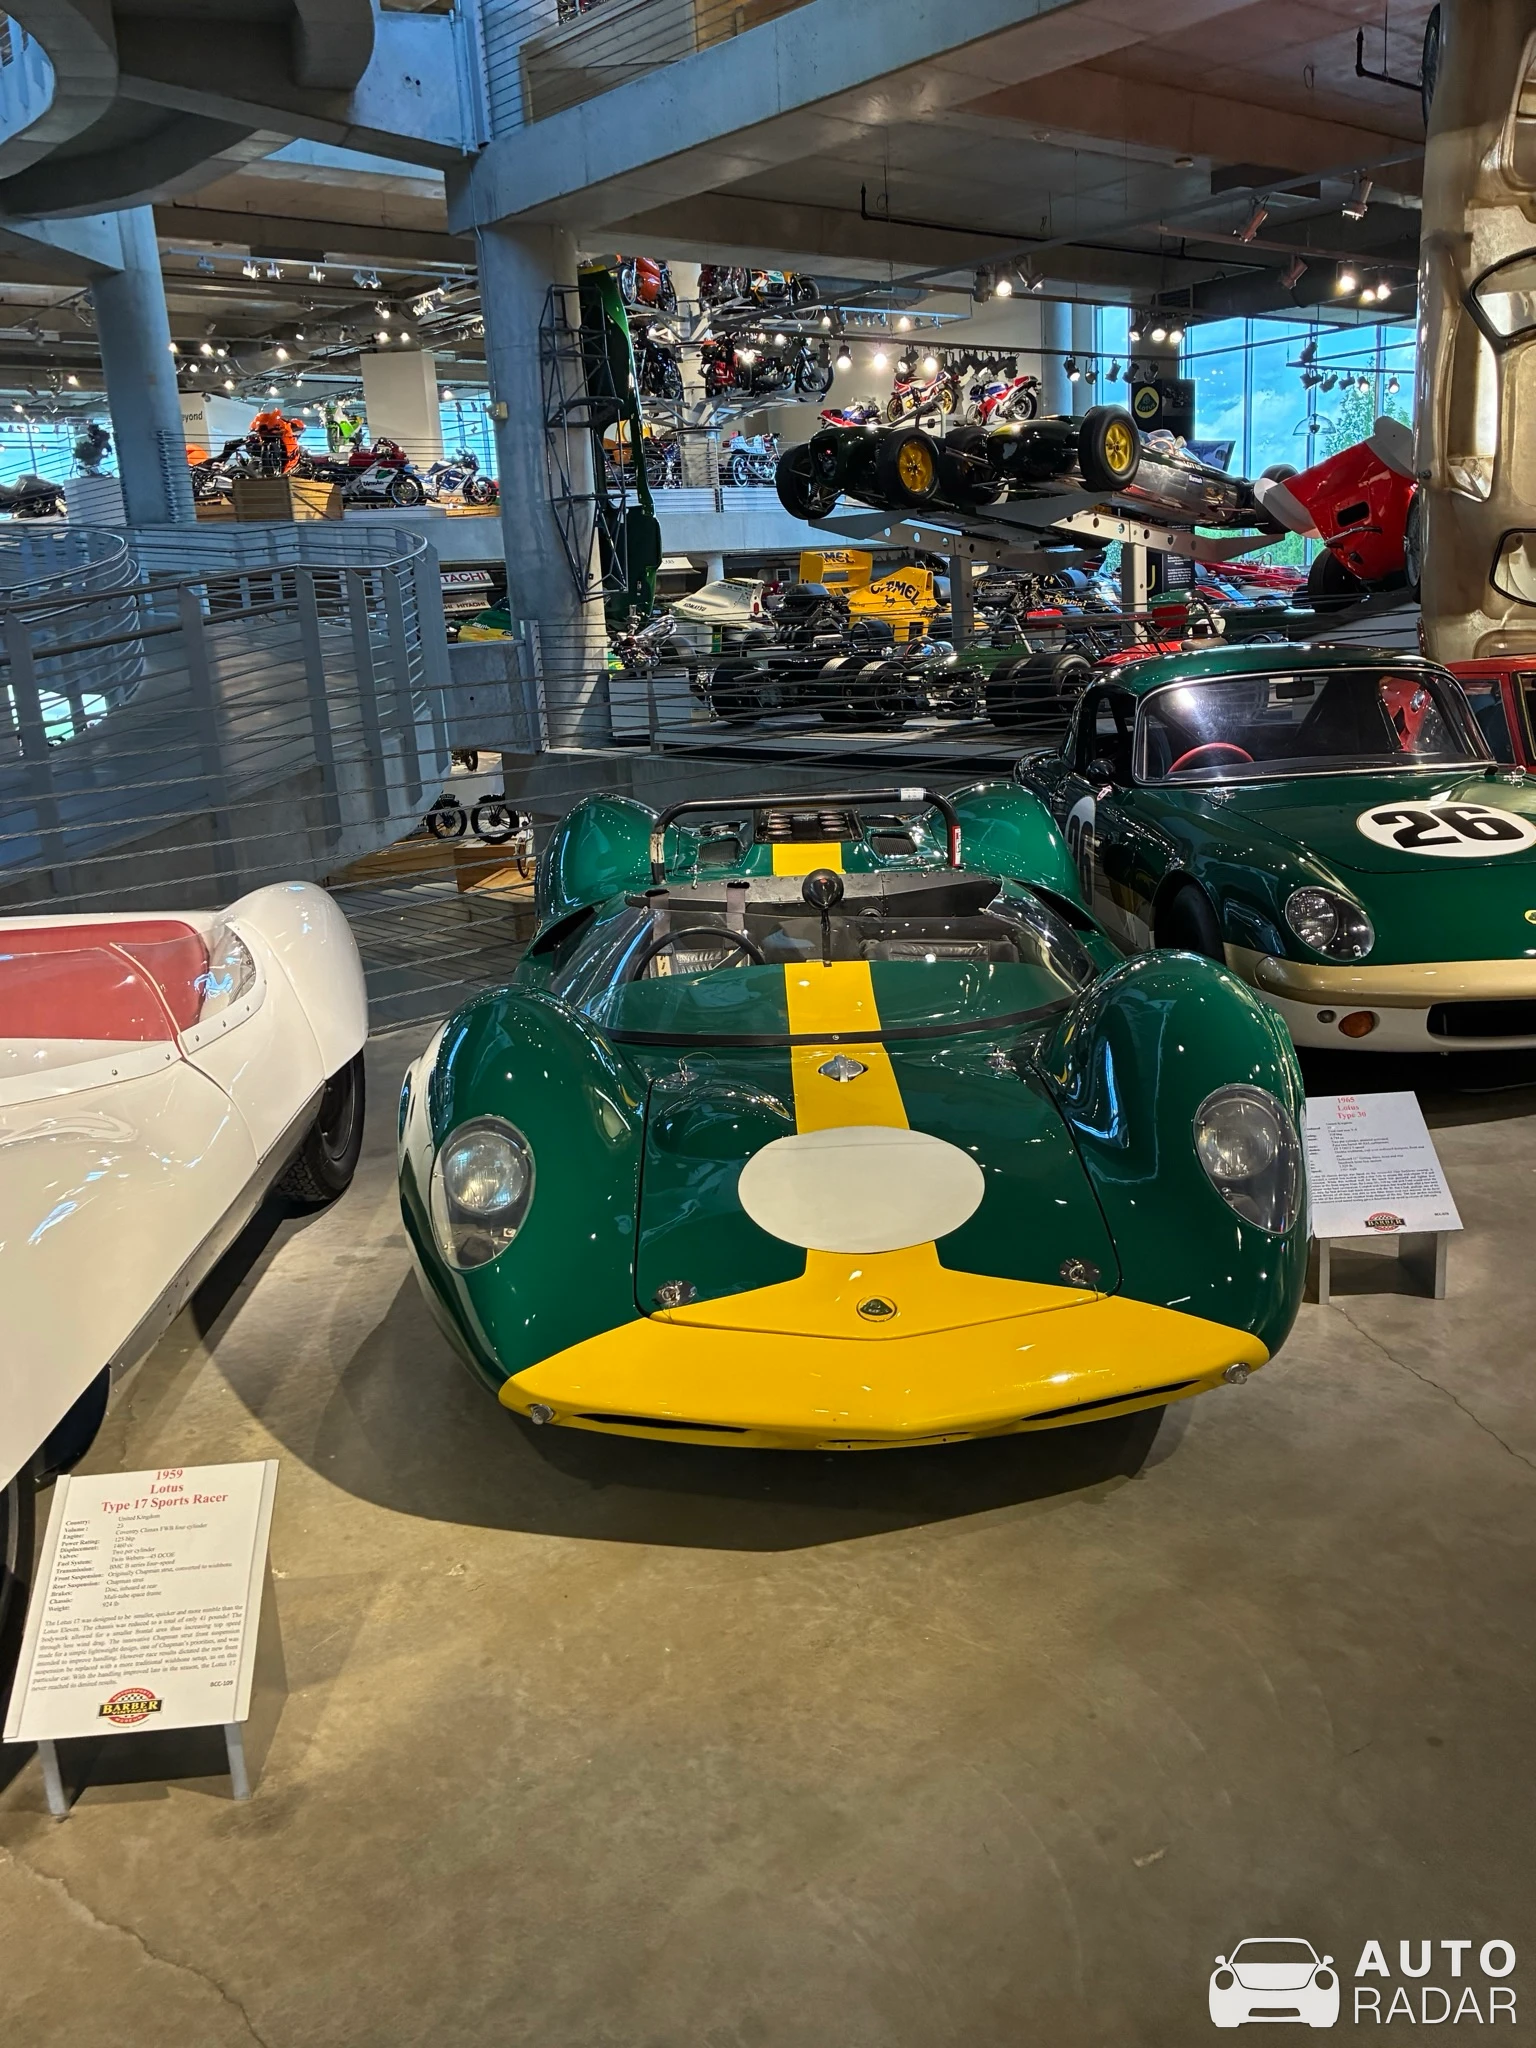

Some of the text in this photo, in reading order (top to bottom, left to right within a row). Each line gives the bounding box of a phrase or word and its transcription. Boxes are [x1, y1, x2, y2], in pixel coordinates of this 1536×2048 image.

[683, 602, 707, 612] KOMATSU
[1371, 807, 1525, 849] 26
[1337, 1096, 1355, 1104] 1965
[1337, 1104, 1360, 1112] Lotus
[1337, 1112, 1356, 1120] Type
[156, 1469, 183, 1481] 1959
[150, 1483, 184, 1494] Lotus
[101, 1492, 229, 1513] Type 17 Sports Racer
[102, 1700, 158, 1715] BARBER
